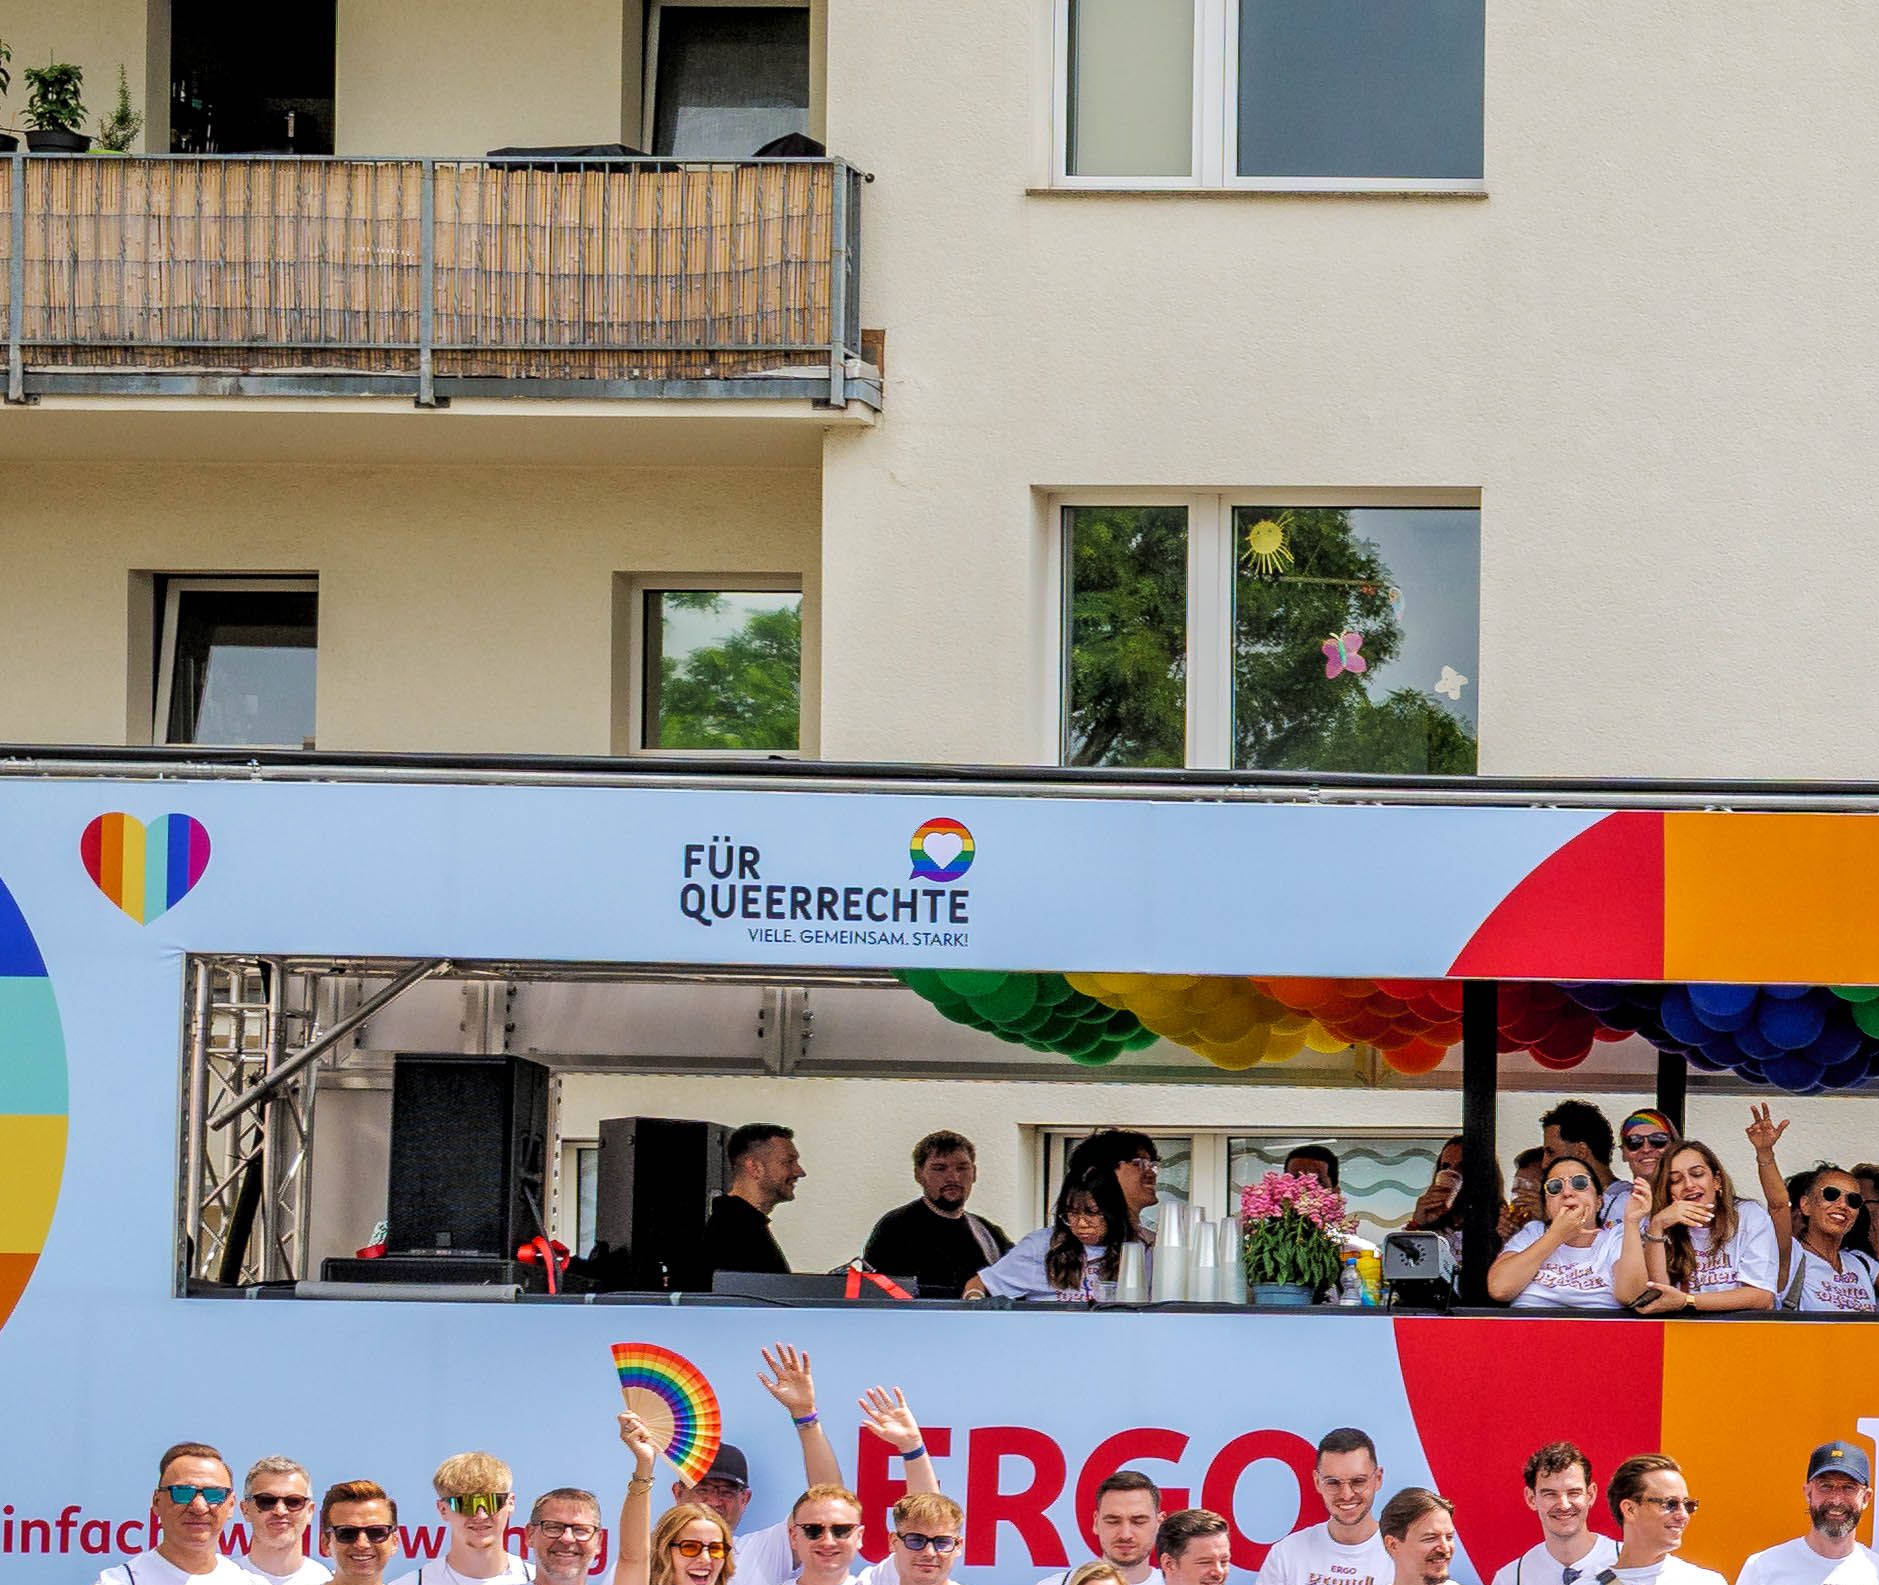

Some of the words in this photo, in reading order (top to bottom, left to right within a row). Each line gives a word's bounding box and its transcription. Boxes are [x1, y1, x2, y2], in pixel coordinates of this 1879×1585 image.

[683, 835, 761, 880] FÜR
[680, 883, 969, 927] QUEERRECHTE
[747, 927, 797, 944] VIELE.
[800, 929, 909, 946] GEMEINSAM.
[912, 931, 968, 948] STARK!
[856, 1425, 1332, 1572] ERGO
[1331, 1565, 1357, 1574] ERGO
